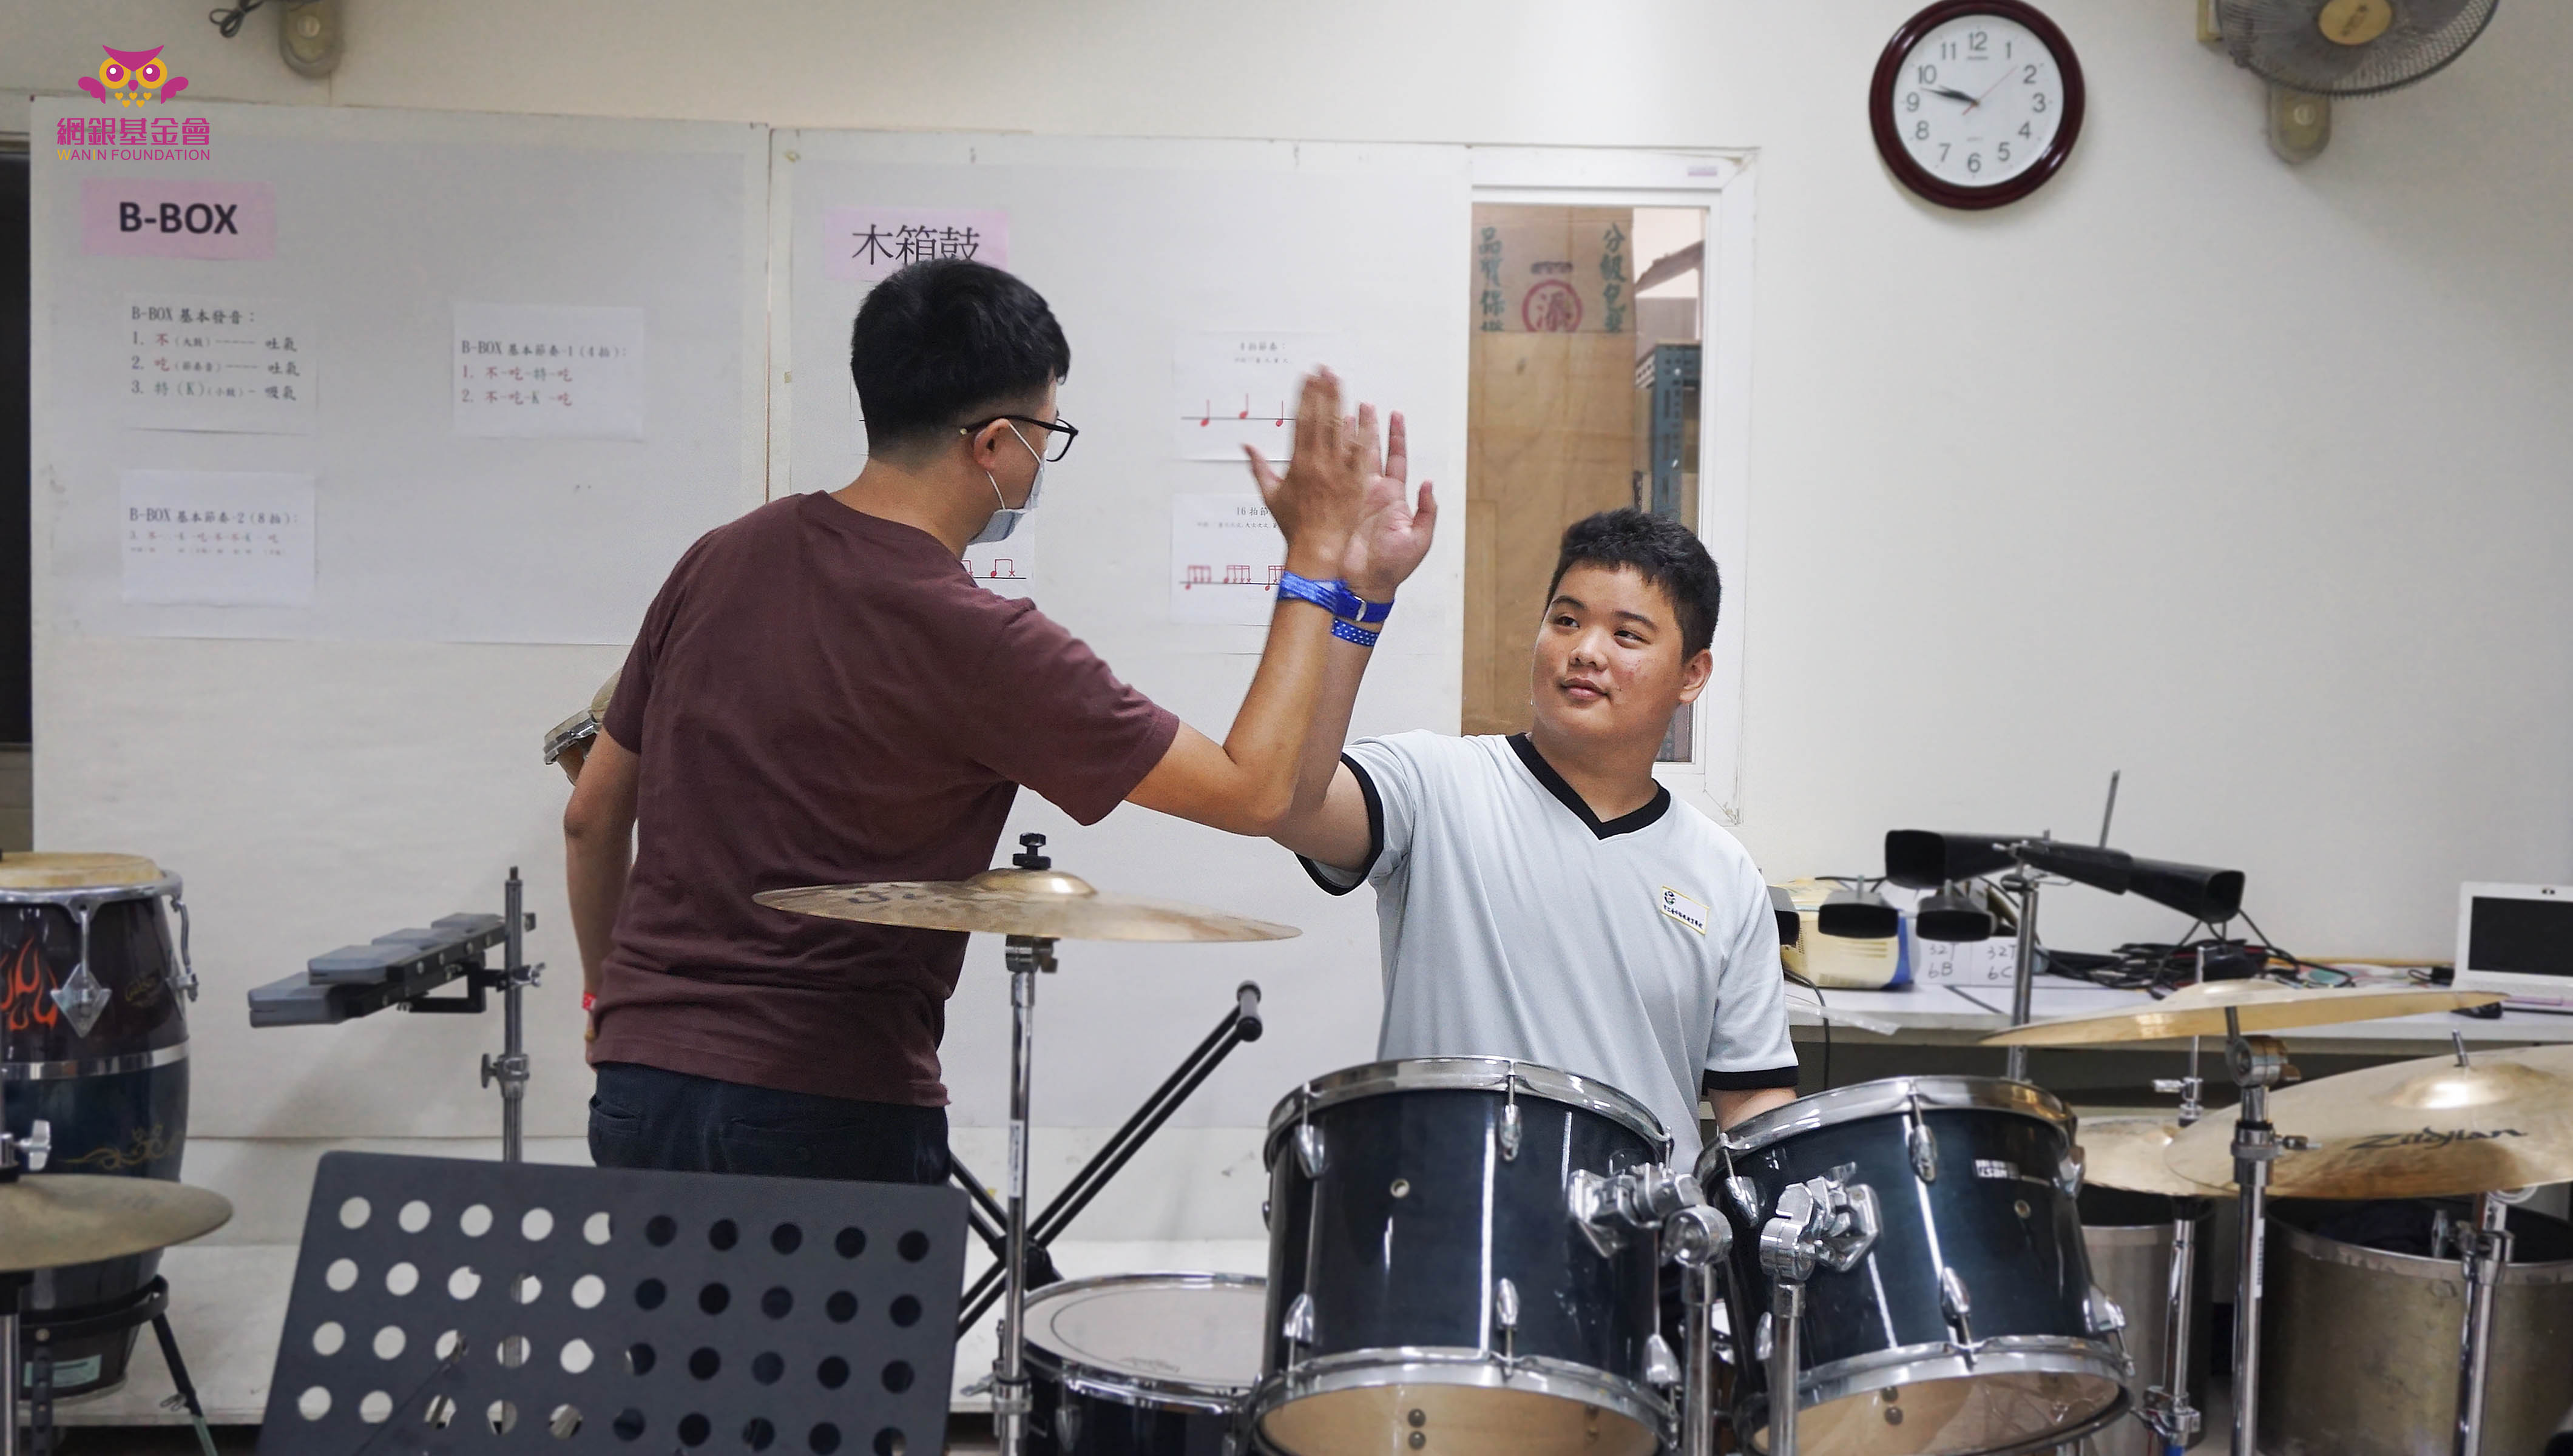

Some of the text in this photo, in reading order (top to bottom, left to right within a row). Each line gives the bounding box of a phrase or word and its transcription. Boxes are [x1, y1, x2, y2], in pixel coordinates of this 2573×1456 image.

[1969, 31, 1988, 51] 12
[2006, 41, 2011, 59] 1
[1941, 42, 1956, 60] 11
[1918, 64, 1936, 84] 10
[2023, 64, 2037, 84] 2
[1907, 92, 1919, 112] 9
[2033, 93, 2046, 112] 3
[1915, 120, 1929, 140] 8
[2018, 121, 2031, 139] 4
[1939, 143, 1951, 161] 7
[1998, 142, 2010, 161] 5
[1967, 152, 1981, 173] 6
[119, 202, 238, 235] B-BOX
[852, 224, 980, 265] 木箱鼓
[132, 306, 173, 321] B-BOX
[462, 340, 502, 355] B-BOX
[129, 507, 172, 522] B-BOX
